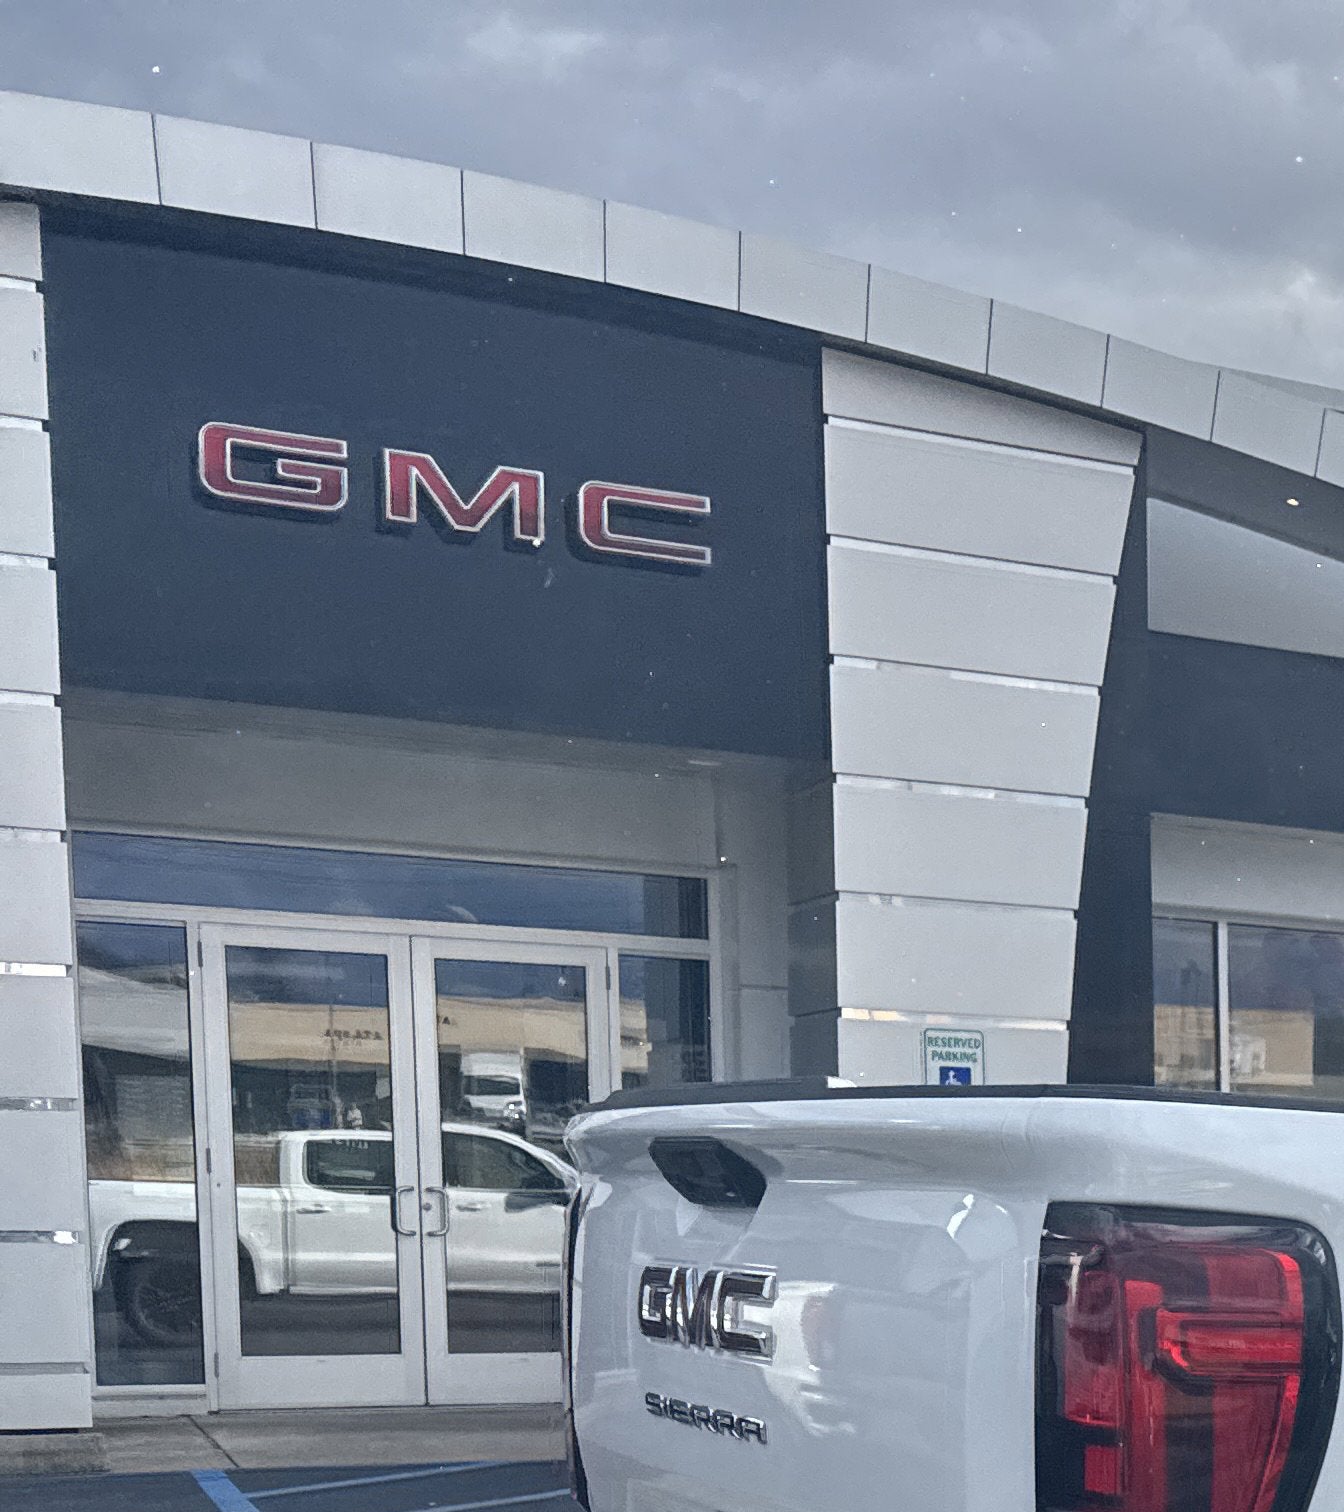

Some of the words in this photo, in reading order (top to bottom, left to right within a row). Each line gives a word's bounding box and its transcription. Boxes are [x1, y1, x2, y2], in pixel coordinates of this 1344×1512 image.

[199, 421, 711, 565] GMC
[926, 1036, 981, 1050] RESERVED
[931, 1049, 978, 1063] PARKING
[638, 1264, 778, 1359] GMC
[645, 1391, 768, 1445] SIERRA
